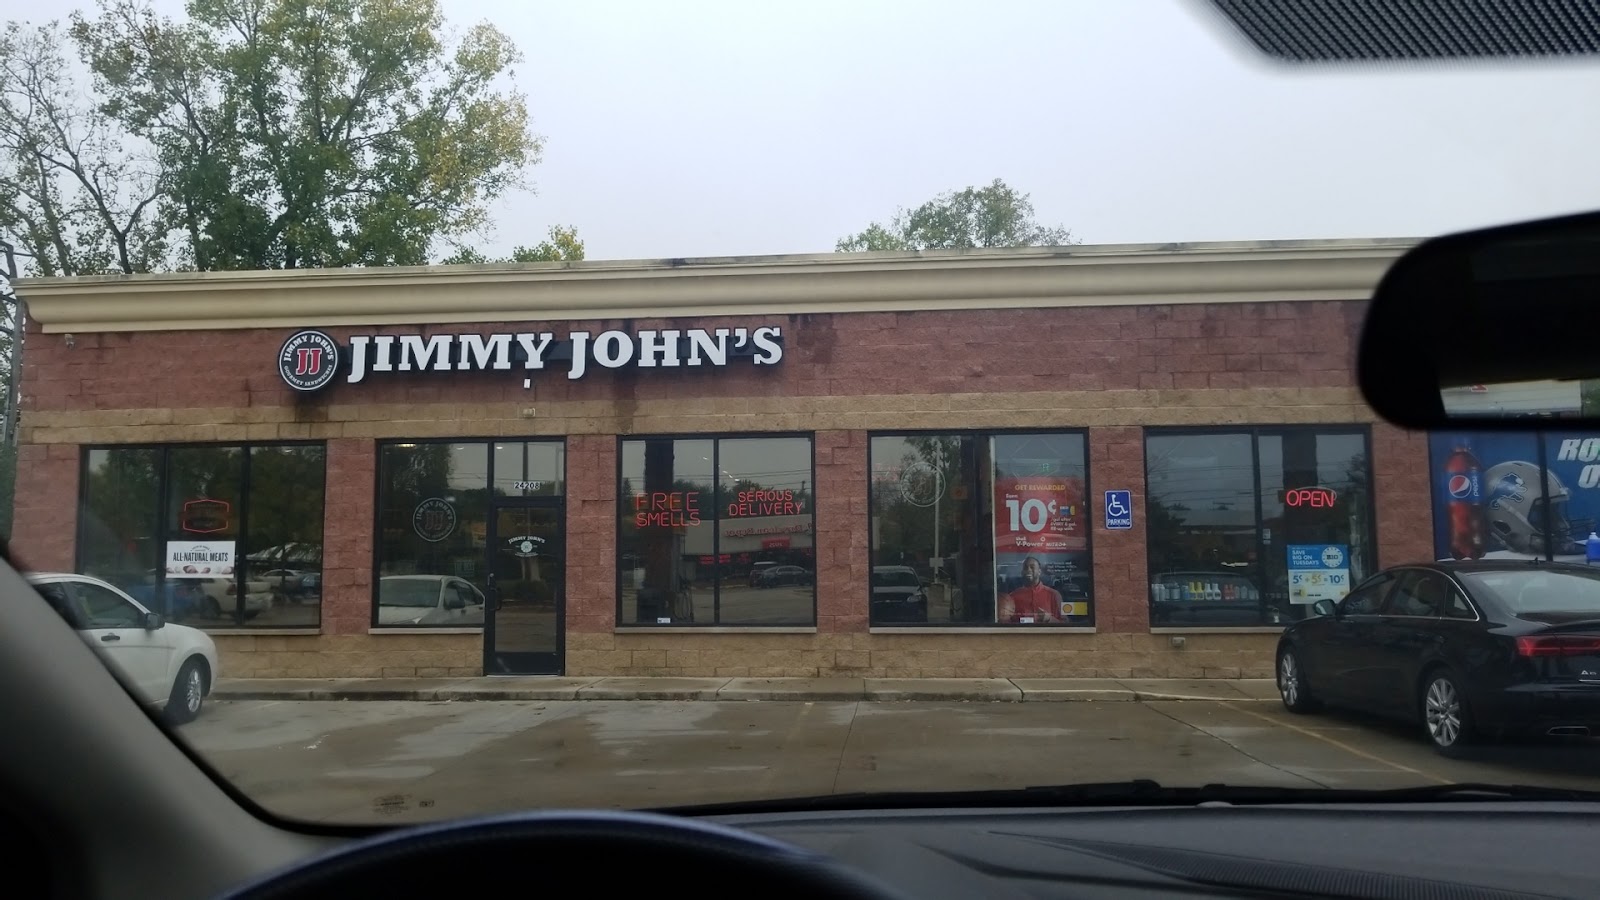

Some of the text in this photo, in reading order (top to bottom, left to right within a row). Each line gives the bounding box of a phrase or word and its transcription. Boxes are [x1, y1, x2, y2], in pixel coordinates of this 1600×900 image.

[283, 335, 334, 362] JIMMY JOHN'S
[347, 326, 784, 384] JIMMY JOHN'S
[295, 348, 322, 375] JJ
[1557, 438, 1600, 462] RO
[636, 492, 700, 512] FREE
[737, 489, 793, 503] SERIOUS
[1286, 489, 1334, 508] OPEN
[728, 502, 804, 516] DELIVERY
[636, 512, 701, 527] SMELLS
[1107, 518, 1130, 526] PARKING
[209, 552, 229, 562] MEATS
